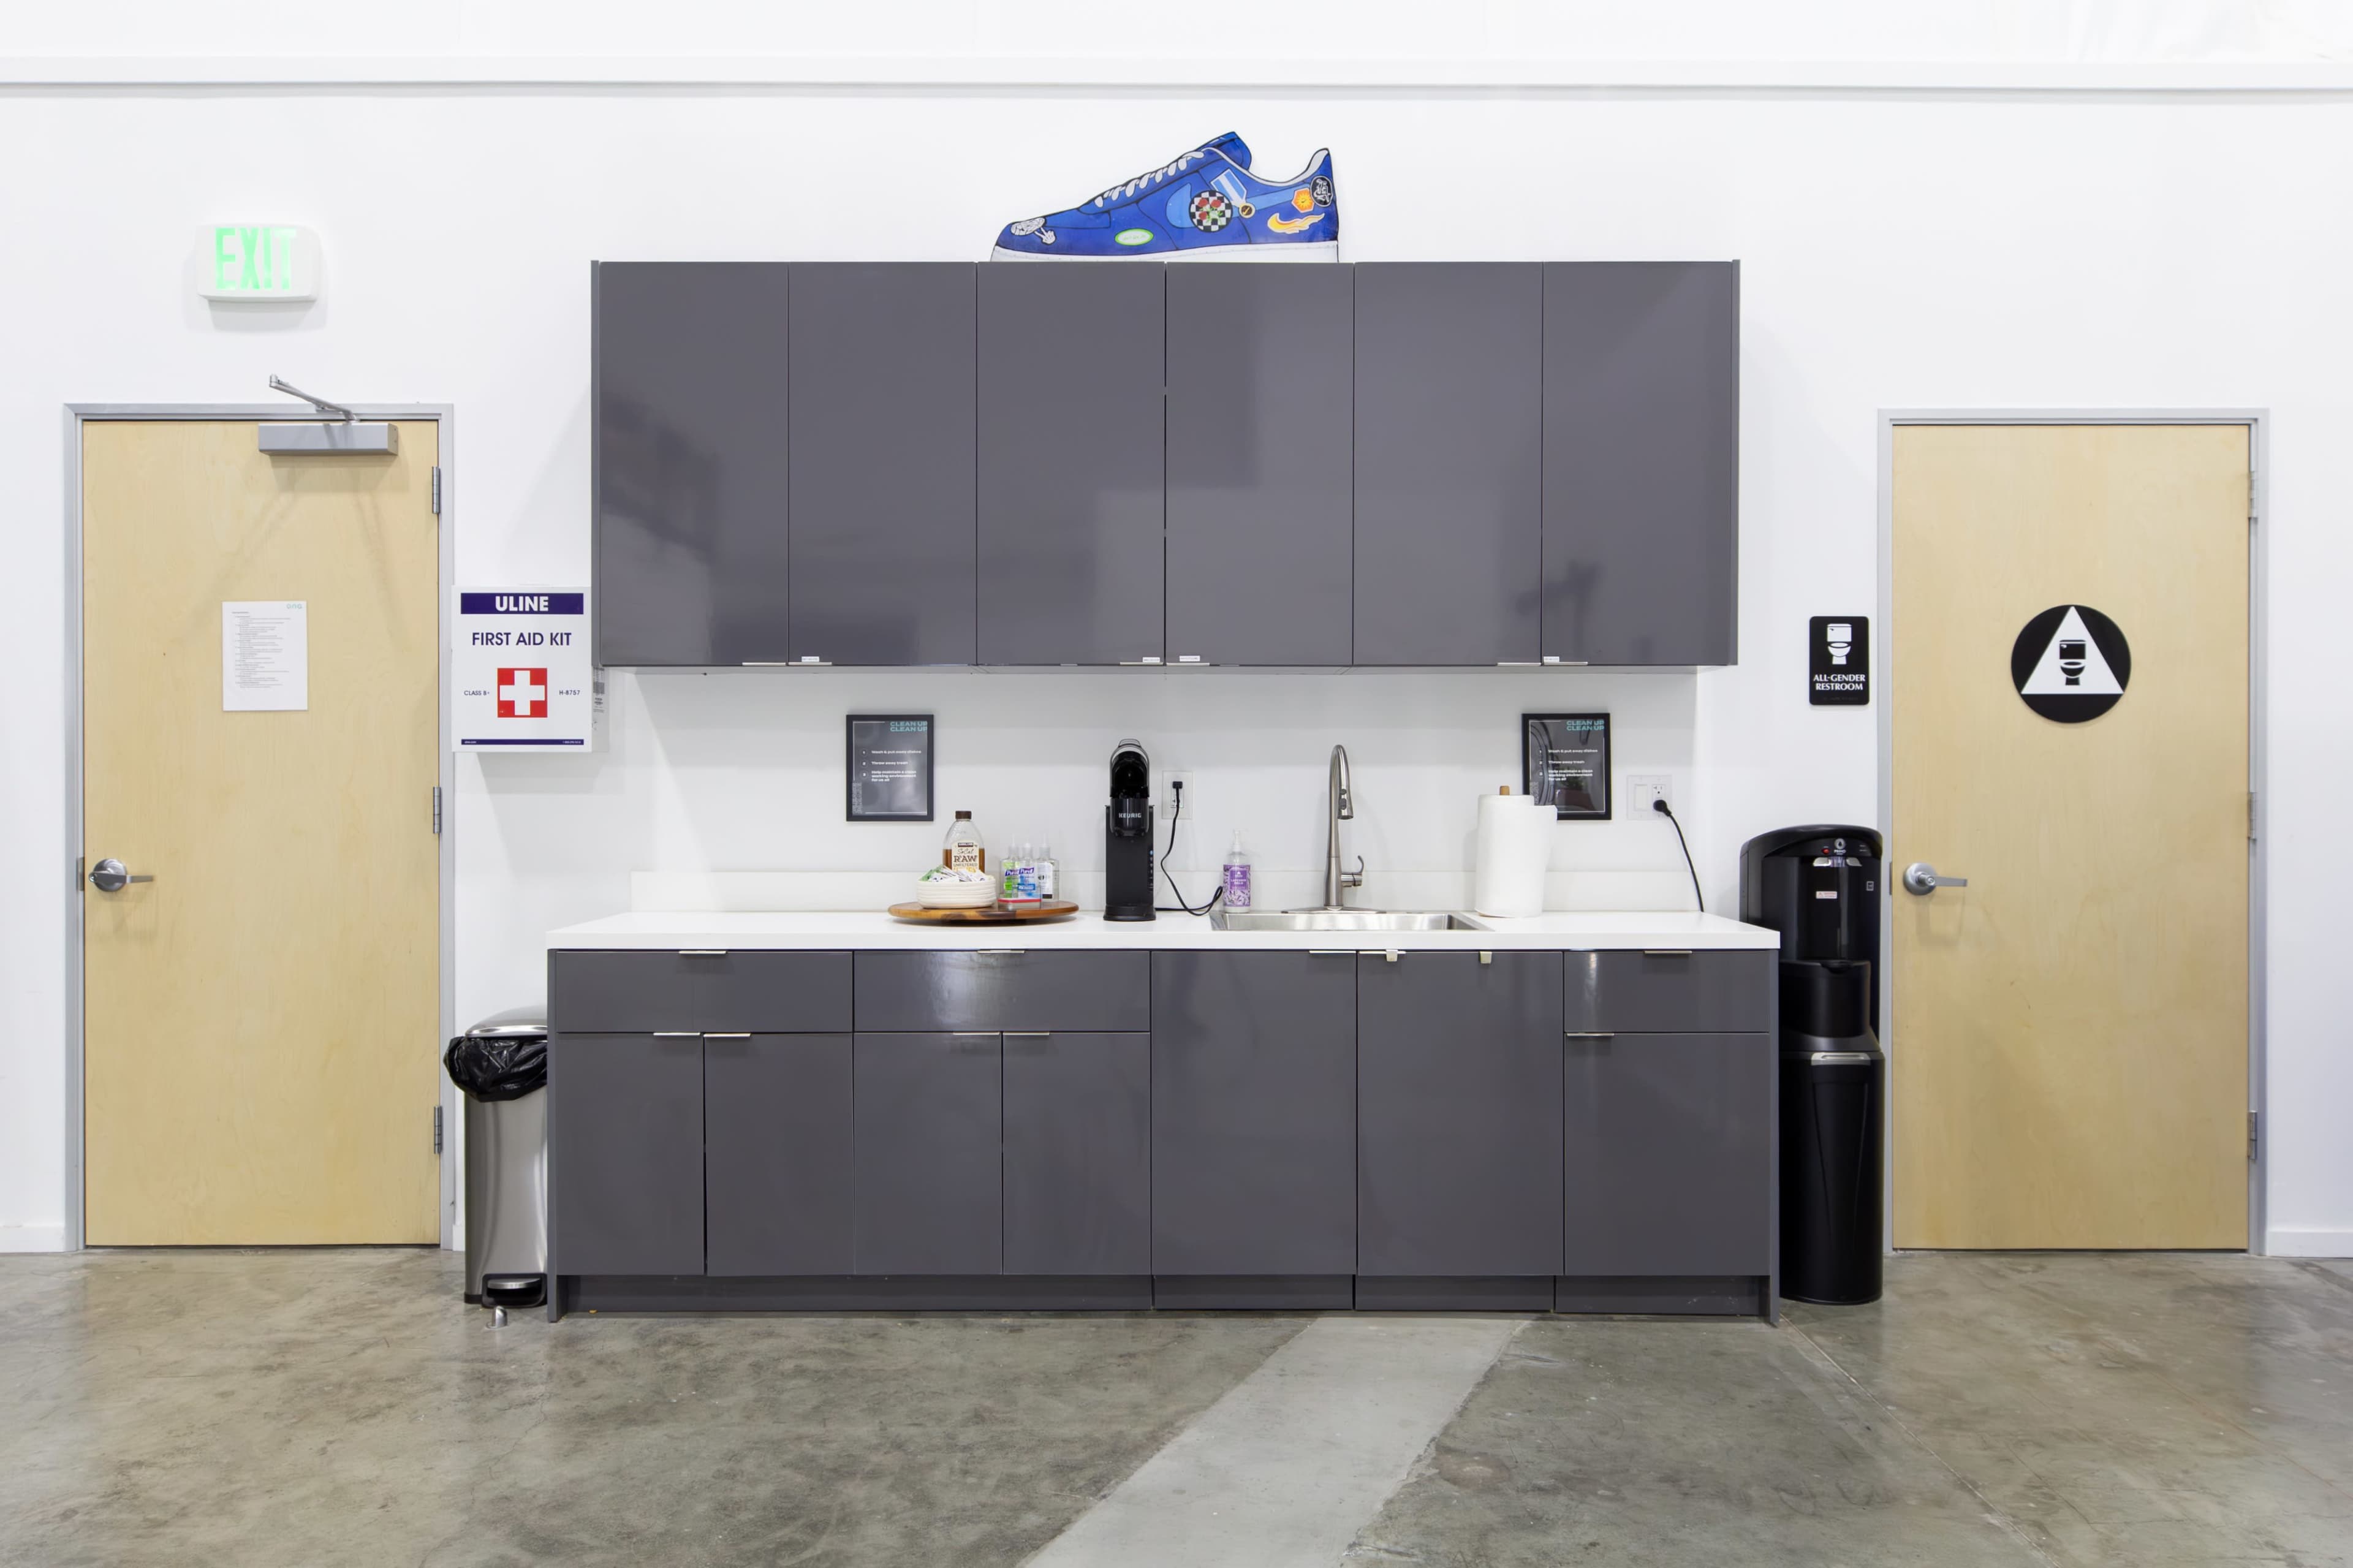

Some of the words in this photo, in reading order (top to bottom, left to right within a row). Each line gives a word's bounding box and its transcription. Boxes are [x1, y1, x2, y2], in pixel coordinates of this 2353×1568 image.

[215, 227, 297, 290] EXIT
[495, 596, 548, 612] ULINE
[472, 632, 512, 646] FIRST
[515, 632, 544, 646] AID
[550, 632, 572, 646] KIT
